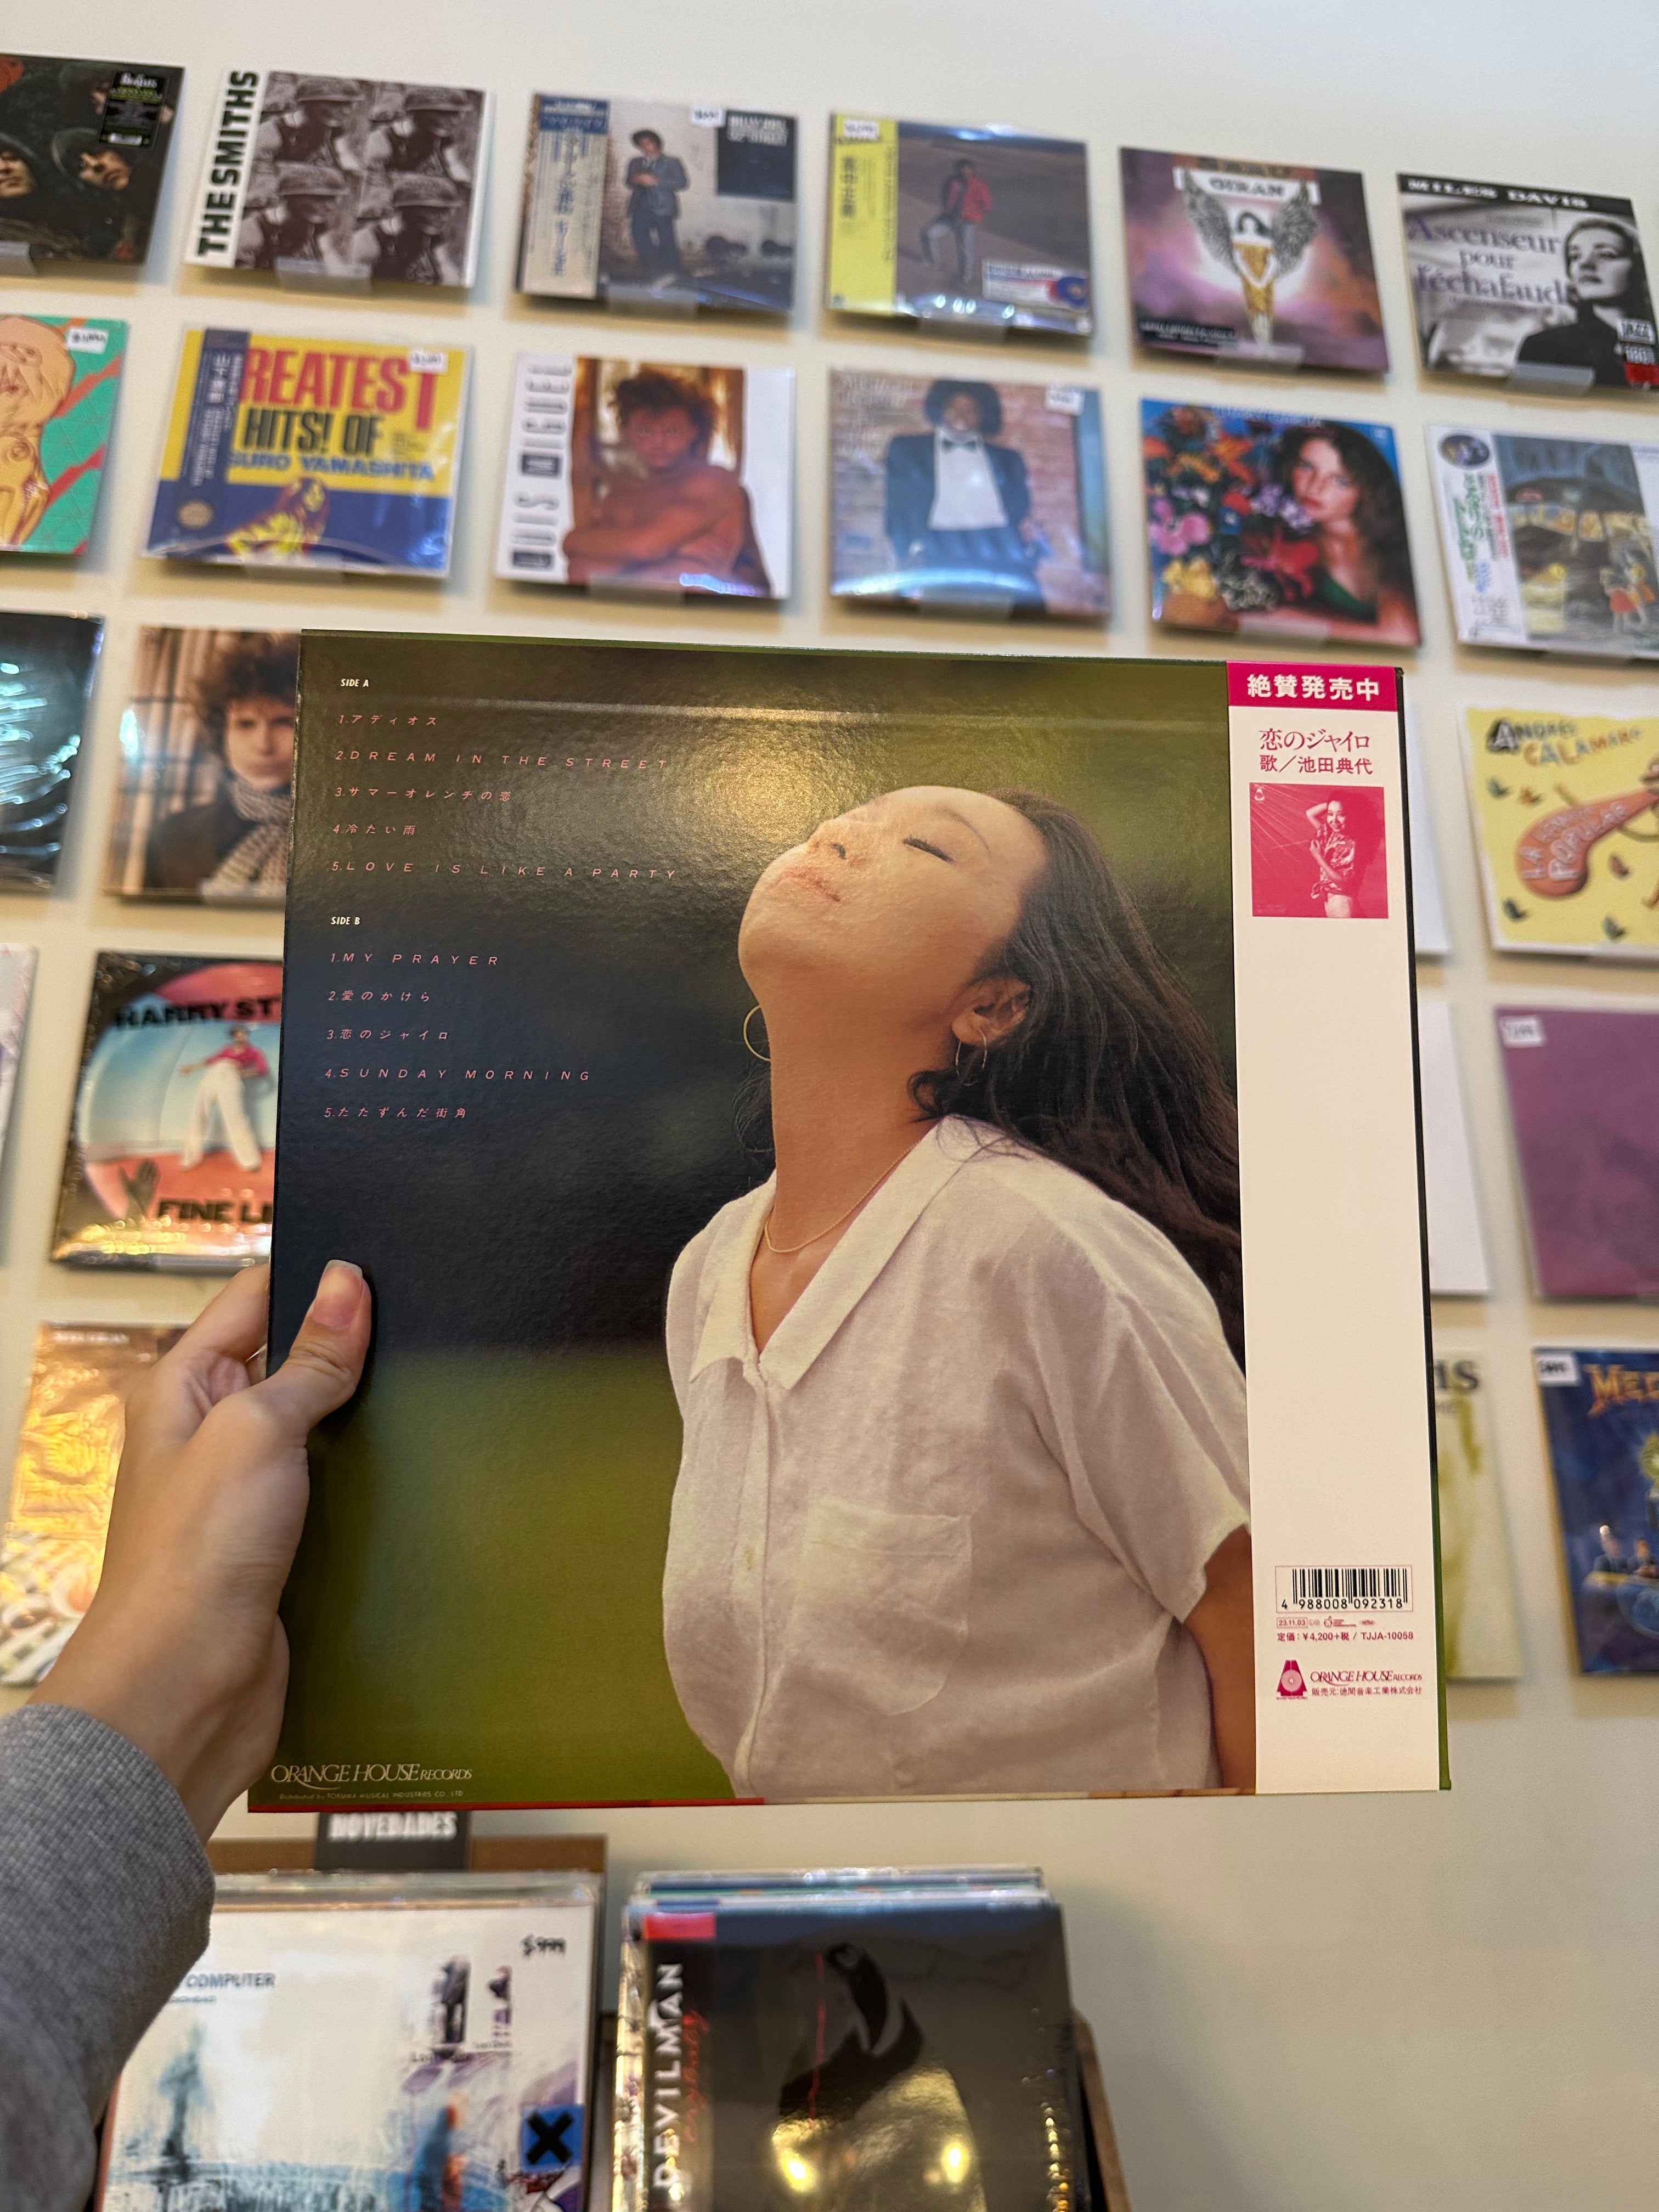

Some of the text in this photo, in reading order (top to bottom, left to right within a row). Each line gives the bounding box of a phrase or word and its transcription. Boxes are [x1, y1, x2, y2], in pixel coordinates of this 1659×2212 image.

[198, 70, 258, 257] THE SMITHS
[1407, 177, 1589, 210] MILES DAVIS
[1459, 249, 1516, 270] pour
[341, 413, 386, 457] OF
[340, 679, 369, 687] SIDE A
[1246, 673, 1379, 702] 絶賛発売中
[1260, 728, 1370, 752] 恋のジャイロ
[456, 754, 482, 764] IN
[501, 755, 546, 766] THE
[566, 757, 667, 769] STREET
[435, 865, 461, 873] IS
[479, 866, 545, 876] LIKE
[565, 868, 572, 877] A
[592, 868, 675, 878] PARTY
[330, 917, 360, 926] SIDE B
[392, 954, 498, 966] PRAYER
[465, 1069, 590, 1081] MORNING
[1279, 1619, 1306, 1627] 23.11.03
[1310, 1671, 1354, 1686] ORANGE
[1356, 1670, 1393, 1682] HOUSE
[271, 1763, 472, 1790] ORANGE HOUSE RECORDS
[328, 1811, 458, 1842] NOVEDADES
[185, 1972, 276, 1989] COMPUTER
[647, 1962, 684, 2190] DEVILMAN
